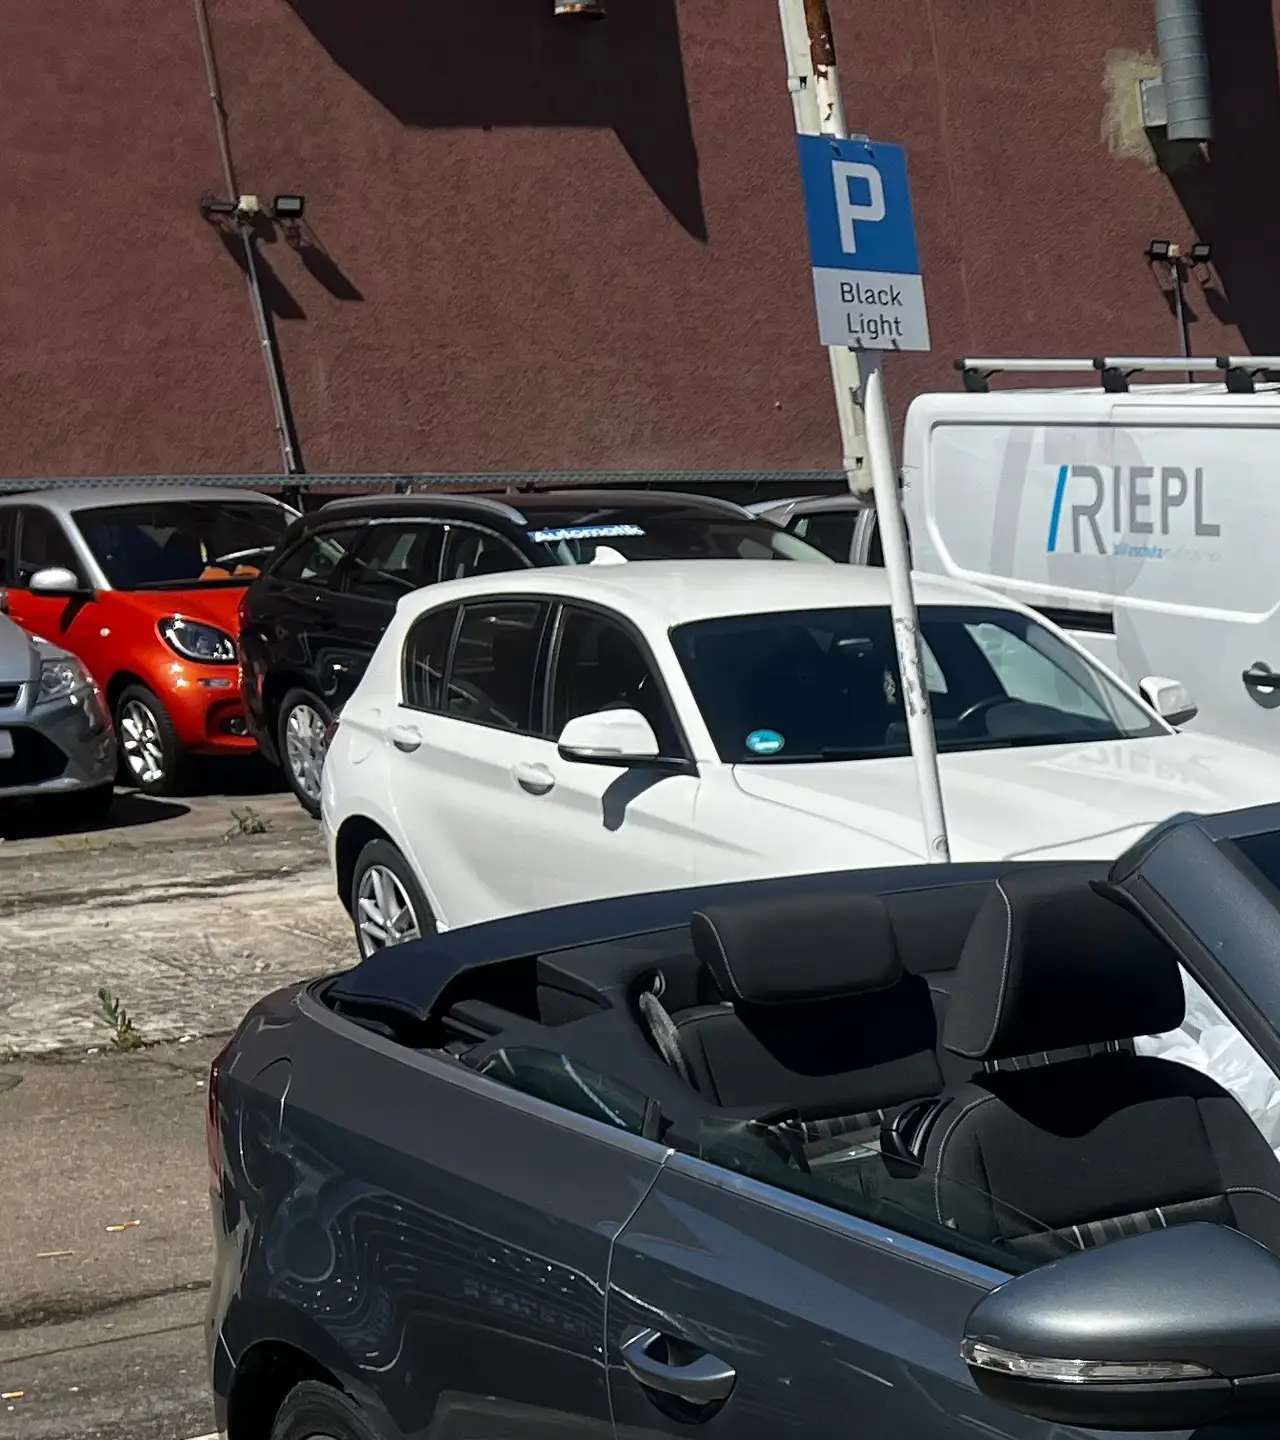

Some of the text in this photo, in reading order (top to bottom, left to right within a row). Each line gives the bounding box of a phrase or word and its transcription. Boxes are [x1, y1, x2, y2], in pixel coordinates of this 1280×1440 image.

[831, 159, 886, 254] P
[840, 282, 903, 307] Black
[847, 312, 903, 340] Light
